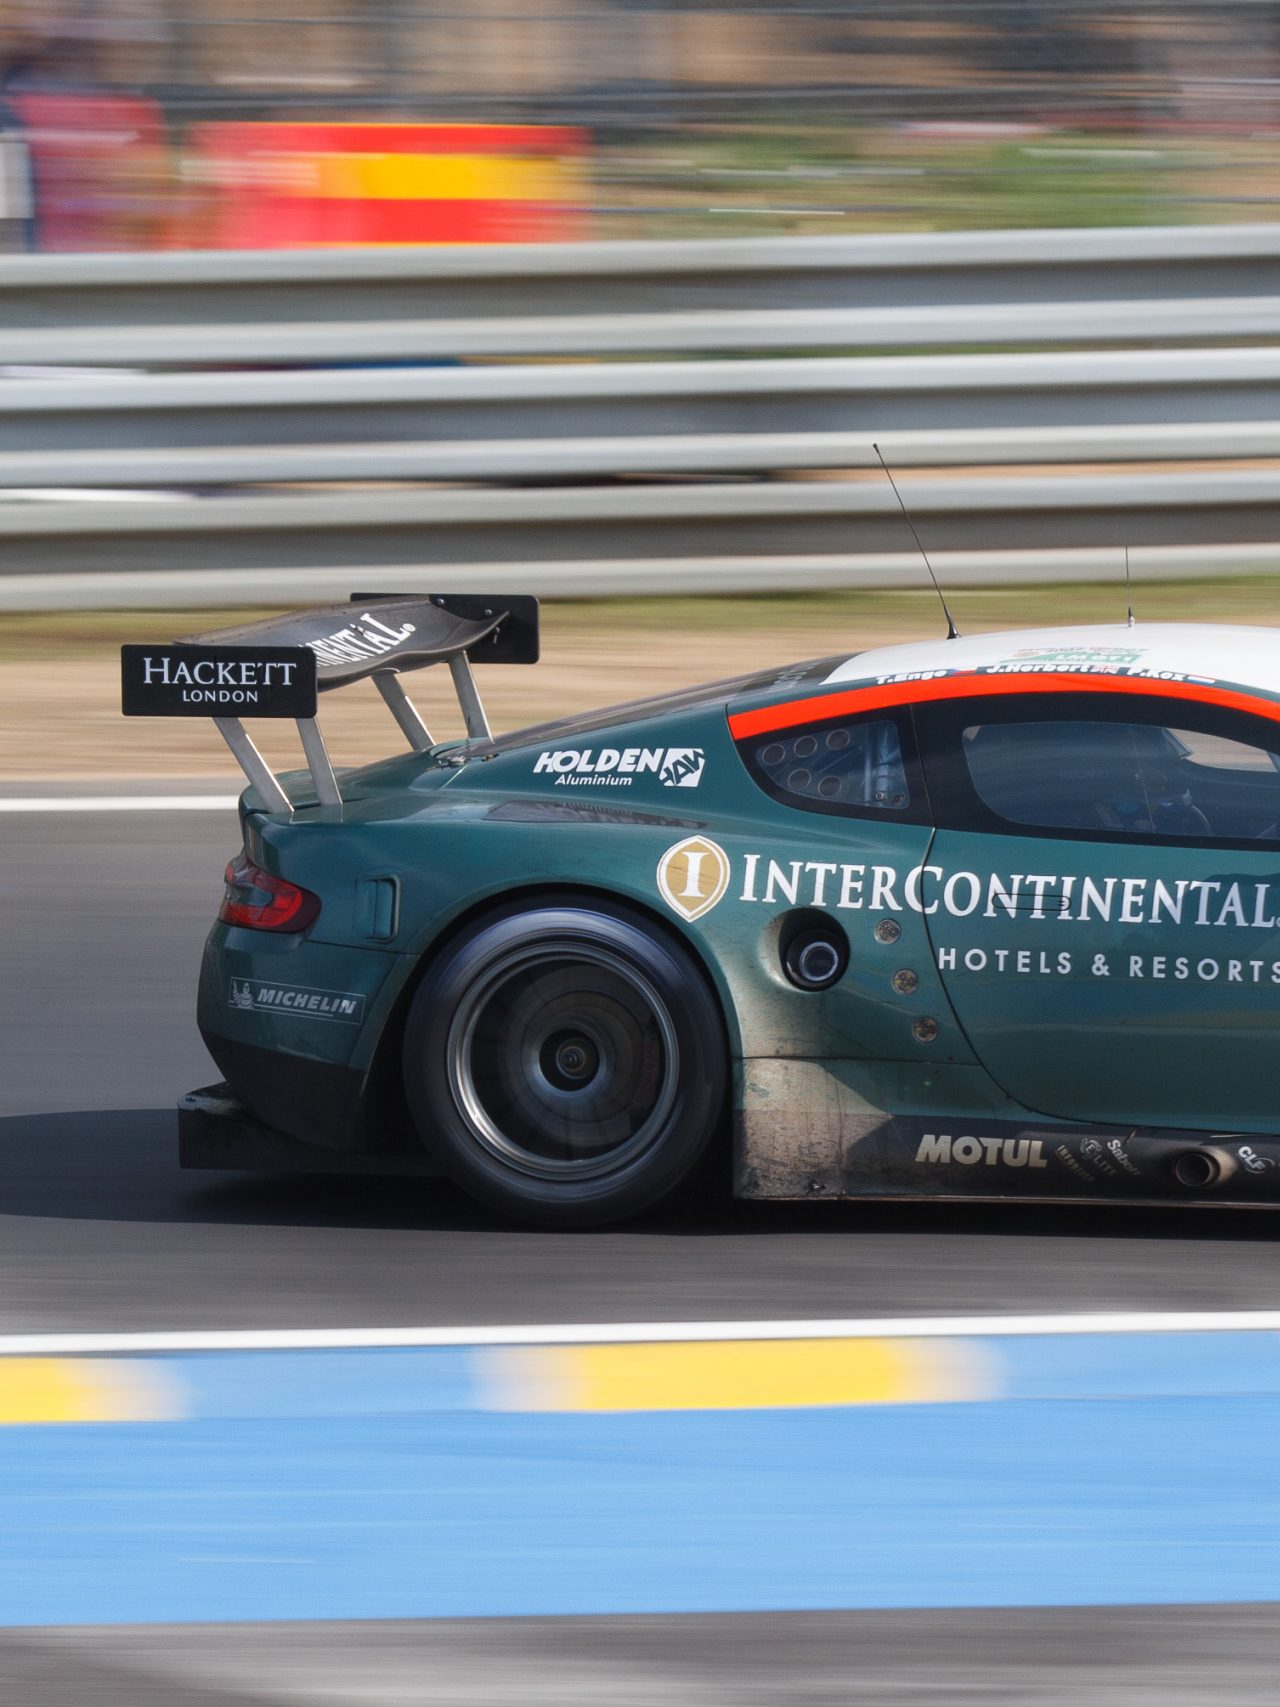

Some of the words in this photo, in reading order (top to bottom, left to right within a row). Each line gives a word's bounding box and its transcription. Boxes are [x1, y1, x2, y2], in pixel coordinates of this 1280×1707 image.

[144, 658, 297, 685] HACKETT
[183, 690, 258, 702] LONDON
[533, 748, 662, 773] HOLDEN
[554, 774, 632, 786] Aluminium
[938, 948, 1072, 975] HOTELS
[1092, 953, 1110, 977] &
[257, 988, 358, 1015] MICHELIN
[915, 1134, 1048, 1168] MOTUL
